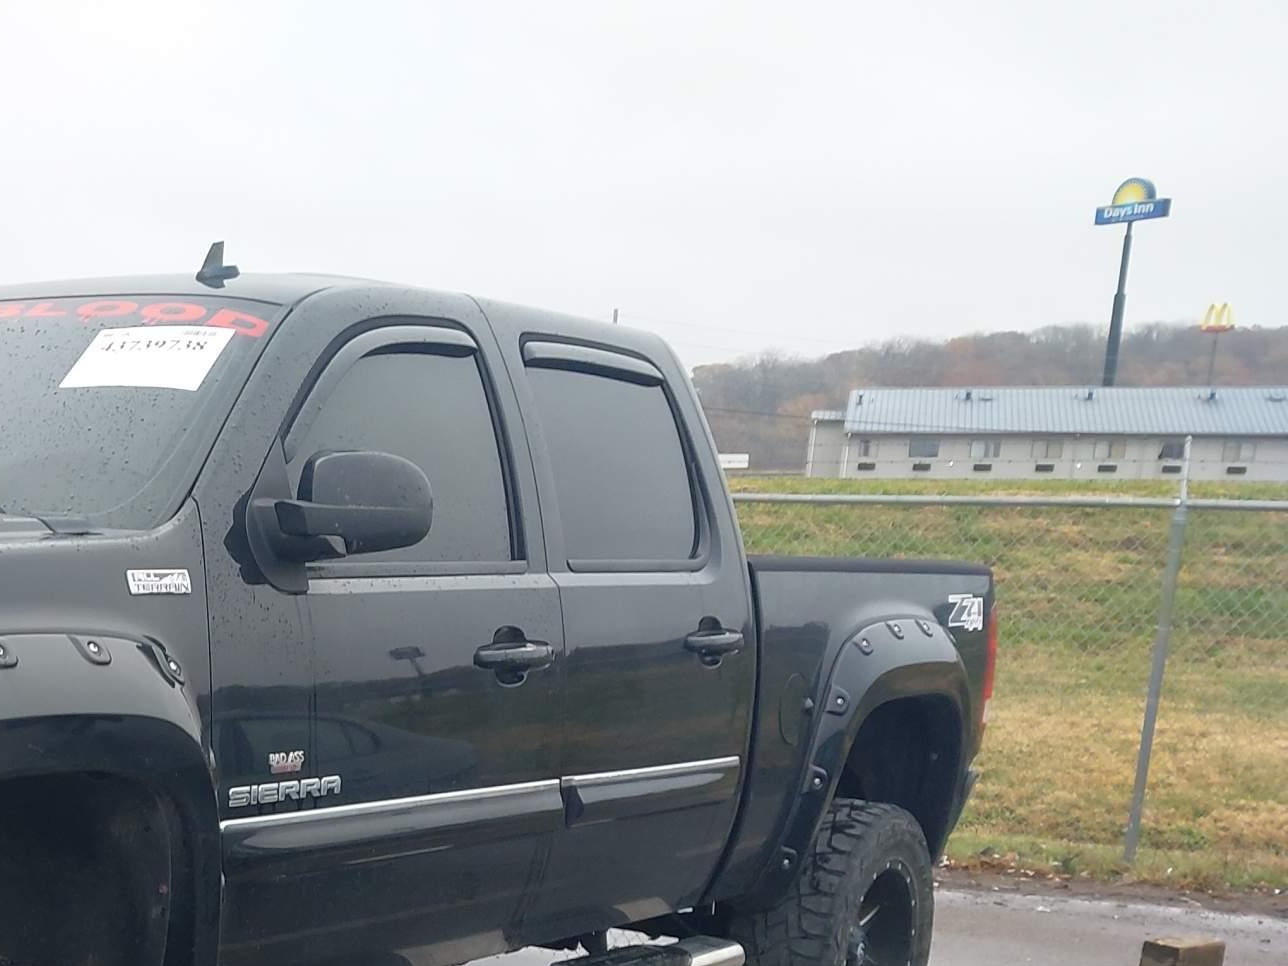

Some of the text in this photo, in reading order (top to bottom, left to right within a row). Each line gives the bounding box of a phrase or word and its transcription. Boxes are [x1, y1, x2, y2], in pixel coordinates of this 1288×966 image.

[1103, 205, 1133, 220] Days
[1133, 202, 1155, 215] Inn
[269, 750, 305, 766] BAD ASS
[228, 775, 342, 807] SIERRA
